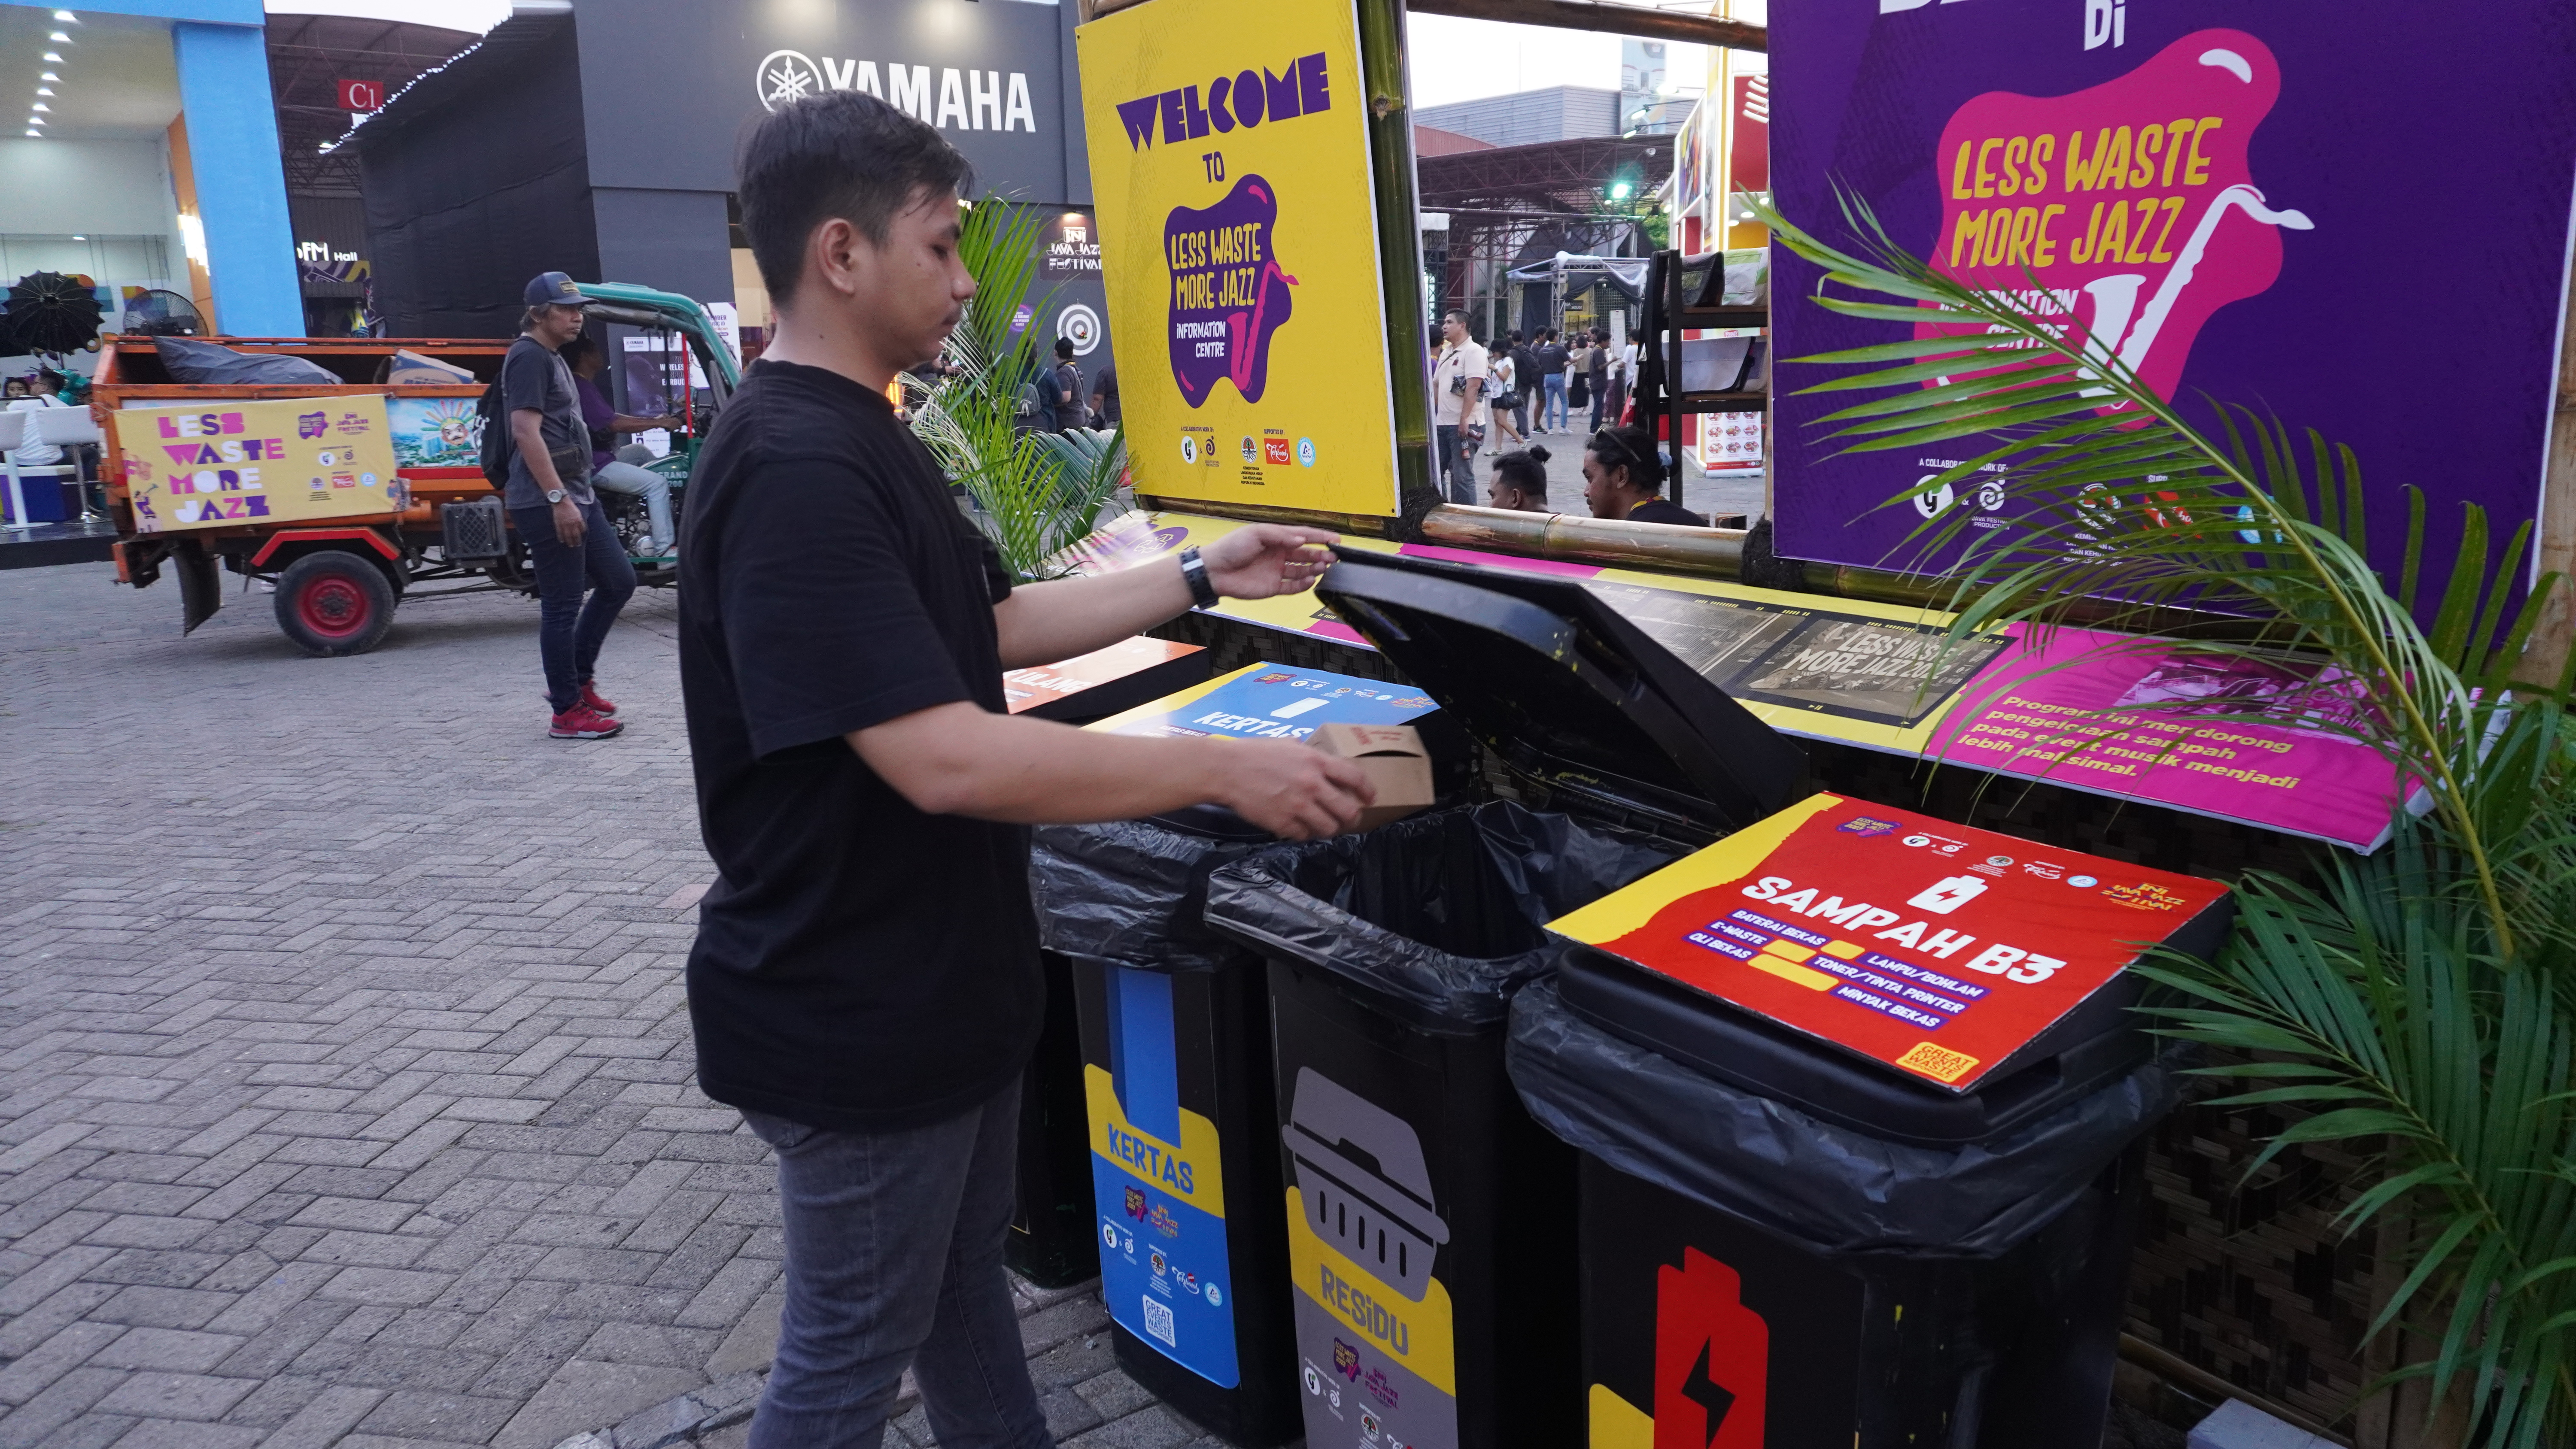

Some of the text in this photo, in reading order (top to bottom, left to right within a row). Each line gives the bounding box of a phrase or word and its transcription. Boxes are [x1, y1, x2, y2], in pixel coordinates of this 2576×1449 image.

[349, 83, 376, 108] C1
[822, 57, 1036, 133] YAMAHA
[1116, 51, 1331, 154] WELCOME
[1203, 151, 1225, 183] TO
[1952, 116, 2223, 200] LESS WASTE
[1951, 197, 2186, 268] MORE JAZZ
[334, 252, 358, 261] Hall
[1046, 243, 1075, 256] JAVA
[1171, 222, 1261, 270] LESS WASTE
[1176, 267, 1255, 310] MORE JAZZ
[1195, 342, 1225, 358] CENTRE
[157, 412, 245, 438] LESS
[161, 438, 286, 466] WASTE
[168, 467, 262, 495] MORE
[175, 495, 270, 523] JAZZ
[1837, 631, 1898, 655] LESS
[1782, 648, 1864, 673] MORE
[1854, 656, 1911, 677] JAZZ
[1010, 671, 1092, 693] ULANG
[1192, 711, 1314, 738] KERTAS
[2106, 712, 2139, 725] ini
[1957, 734, 2015, 752] lebih
[1971, 723, 2030, 740] pada
[2184, 760, 2301, 789] menjadi
[1710, 921, 1768, 946] E-WASTE
[1741, 876, 2067, 985] SAMPAH B3
[1782, 925, 1827, 947] BEKAS
[1707, 940, 1753, 961] BEKAS
[1867, 954, 1984, 999] LAMPU/BOHLAM
[1889, 1004, 1941, 1029] BEKAS
[1909, 1055, 1957, 1076] WASTE
[1916, 1050, 1965, 1072] EVENTS
[1922, 1046, 1973, 1066] GREAT
[1108, 1123, 1194, 1194] KERTAS
[1146, 1300, 1170, 1322] GREAT
[1147, 1309, 1171, 1329] EVENTS
[1147, 1316, 1172, 1338] WASTE
